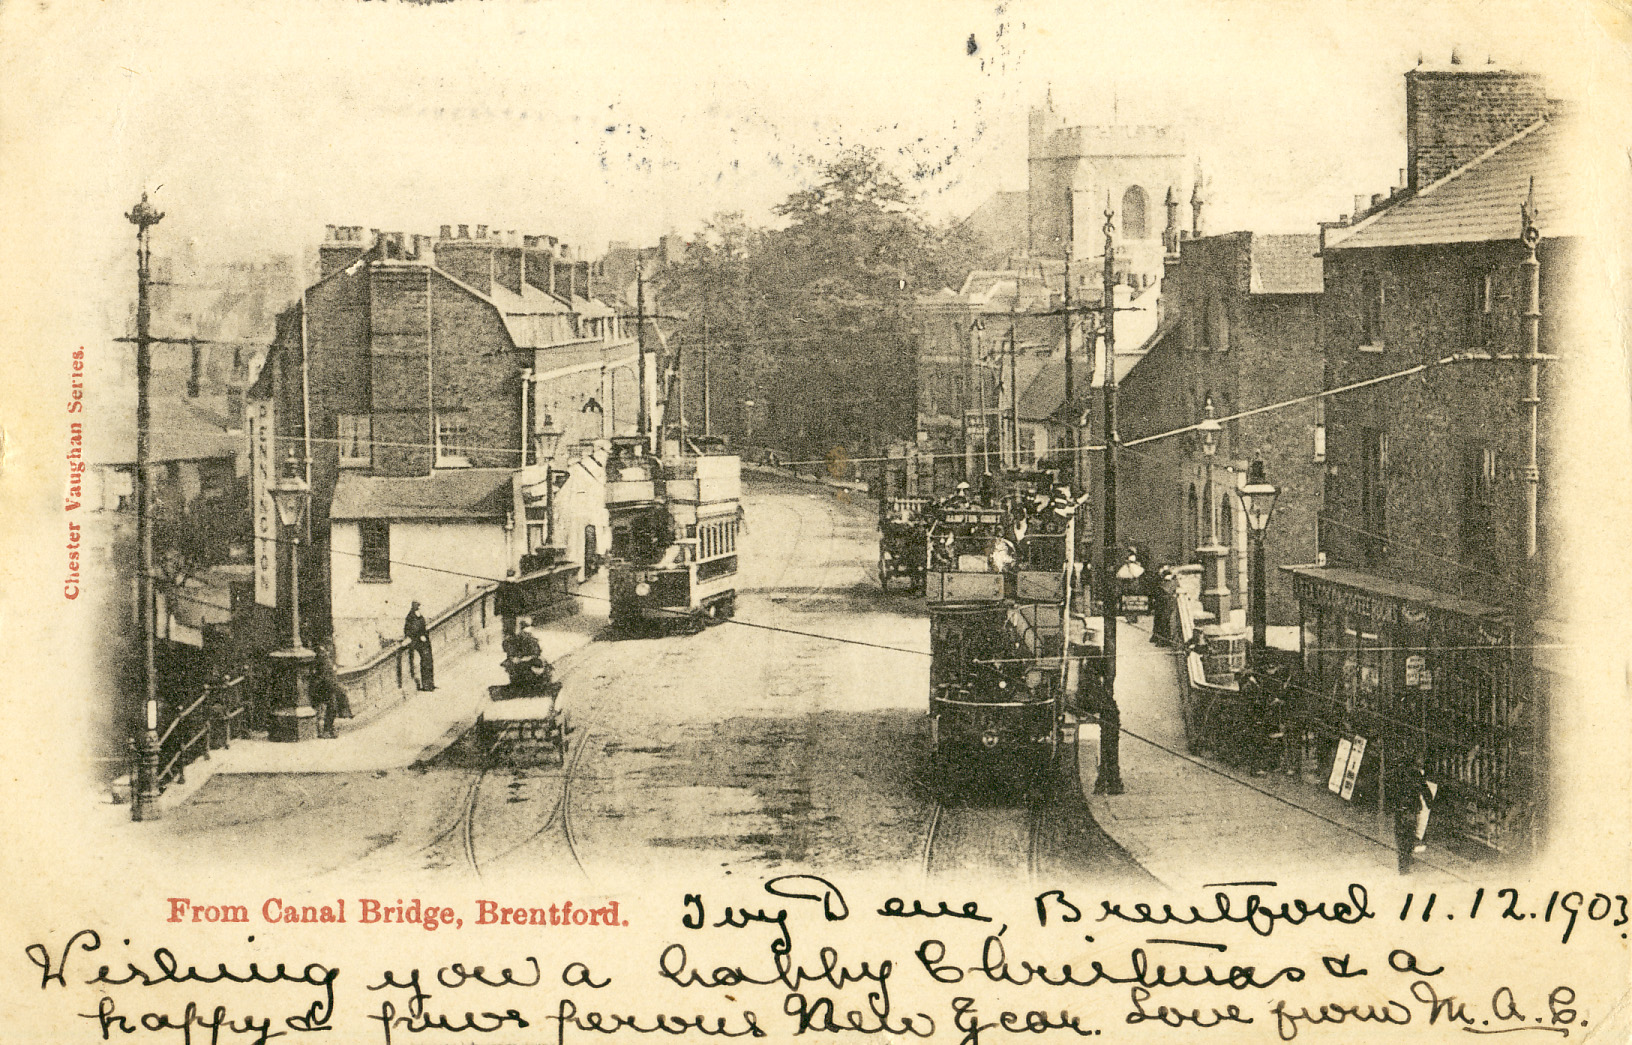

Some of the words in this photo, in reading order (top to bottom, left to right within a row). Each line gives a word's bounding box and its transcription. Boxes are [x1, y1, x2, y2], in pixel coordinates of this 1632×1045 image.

[682, 893, 792, 955] Ivy
[1035, 881, 1375, 936] Brentford
[25, 929, 340, 1026] Wishing
[366, 956, 541, 1019] you
[562, 962, 612, 988] a
[657, 943, 892, 1019] happy
[914, 935, 1306, 990] Christmas
[1322, 954, 1368, 977] &
[1388, 949, 1445, 976] a
[77, 996, 287, 1044] happy
[783, 993, 936, 1038] New
[1126, 986, 1254, 1027] Love
[1269, 999, 1412, 1041] from
